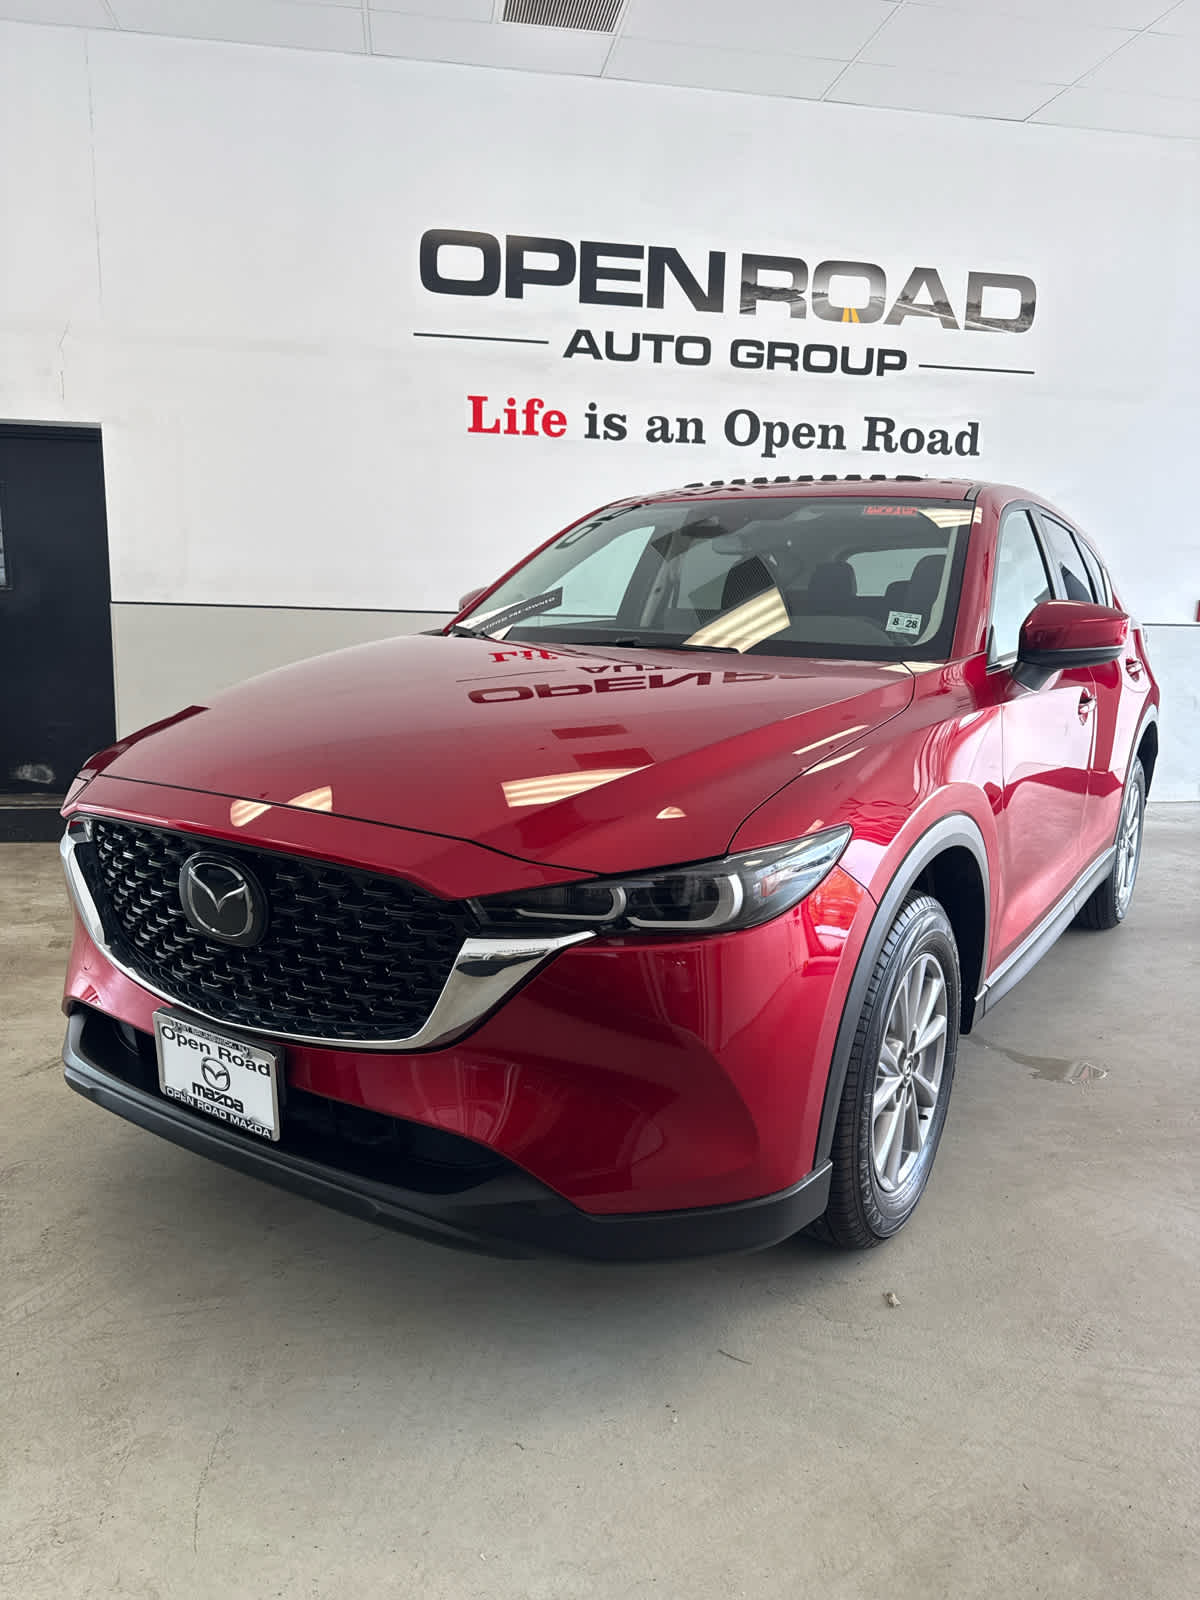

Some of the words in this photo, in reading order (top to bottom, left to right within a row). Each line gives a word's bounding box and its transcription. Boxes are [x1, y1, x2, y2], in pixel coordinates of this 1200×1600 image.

[562, 328, 712, 367] AUTO
[729, 338, 908, 377] GROUP
[466, 395, 568, 438] Life
[584, 402, 628, 441] is
[645, 415, 707, 445] an
[724, 408, 847, 459] Open
[861, 416, 980, 457] Road
[892, 617, 900, 626] 8
[905, 619, 918, 629] 28
[161, 1025, 211, 1056] Open
[217, 1045, 271, 1077] Road
[166, 1087, 195, 1106] OPEN
[197, 1102, 227, 1119] ROAD
[229, 1115, 272, 1139] MAZDA
[191, 1081, 245, 1114] mazda
